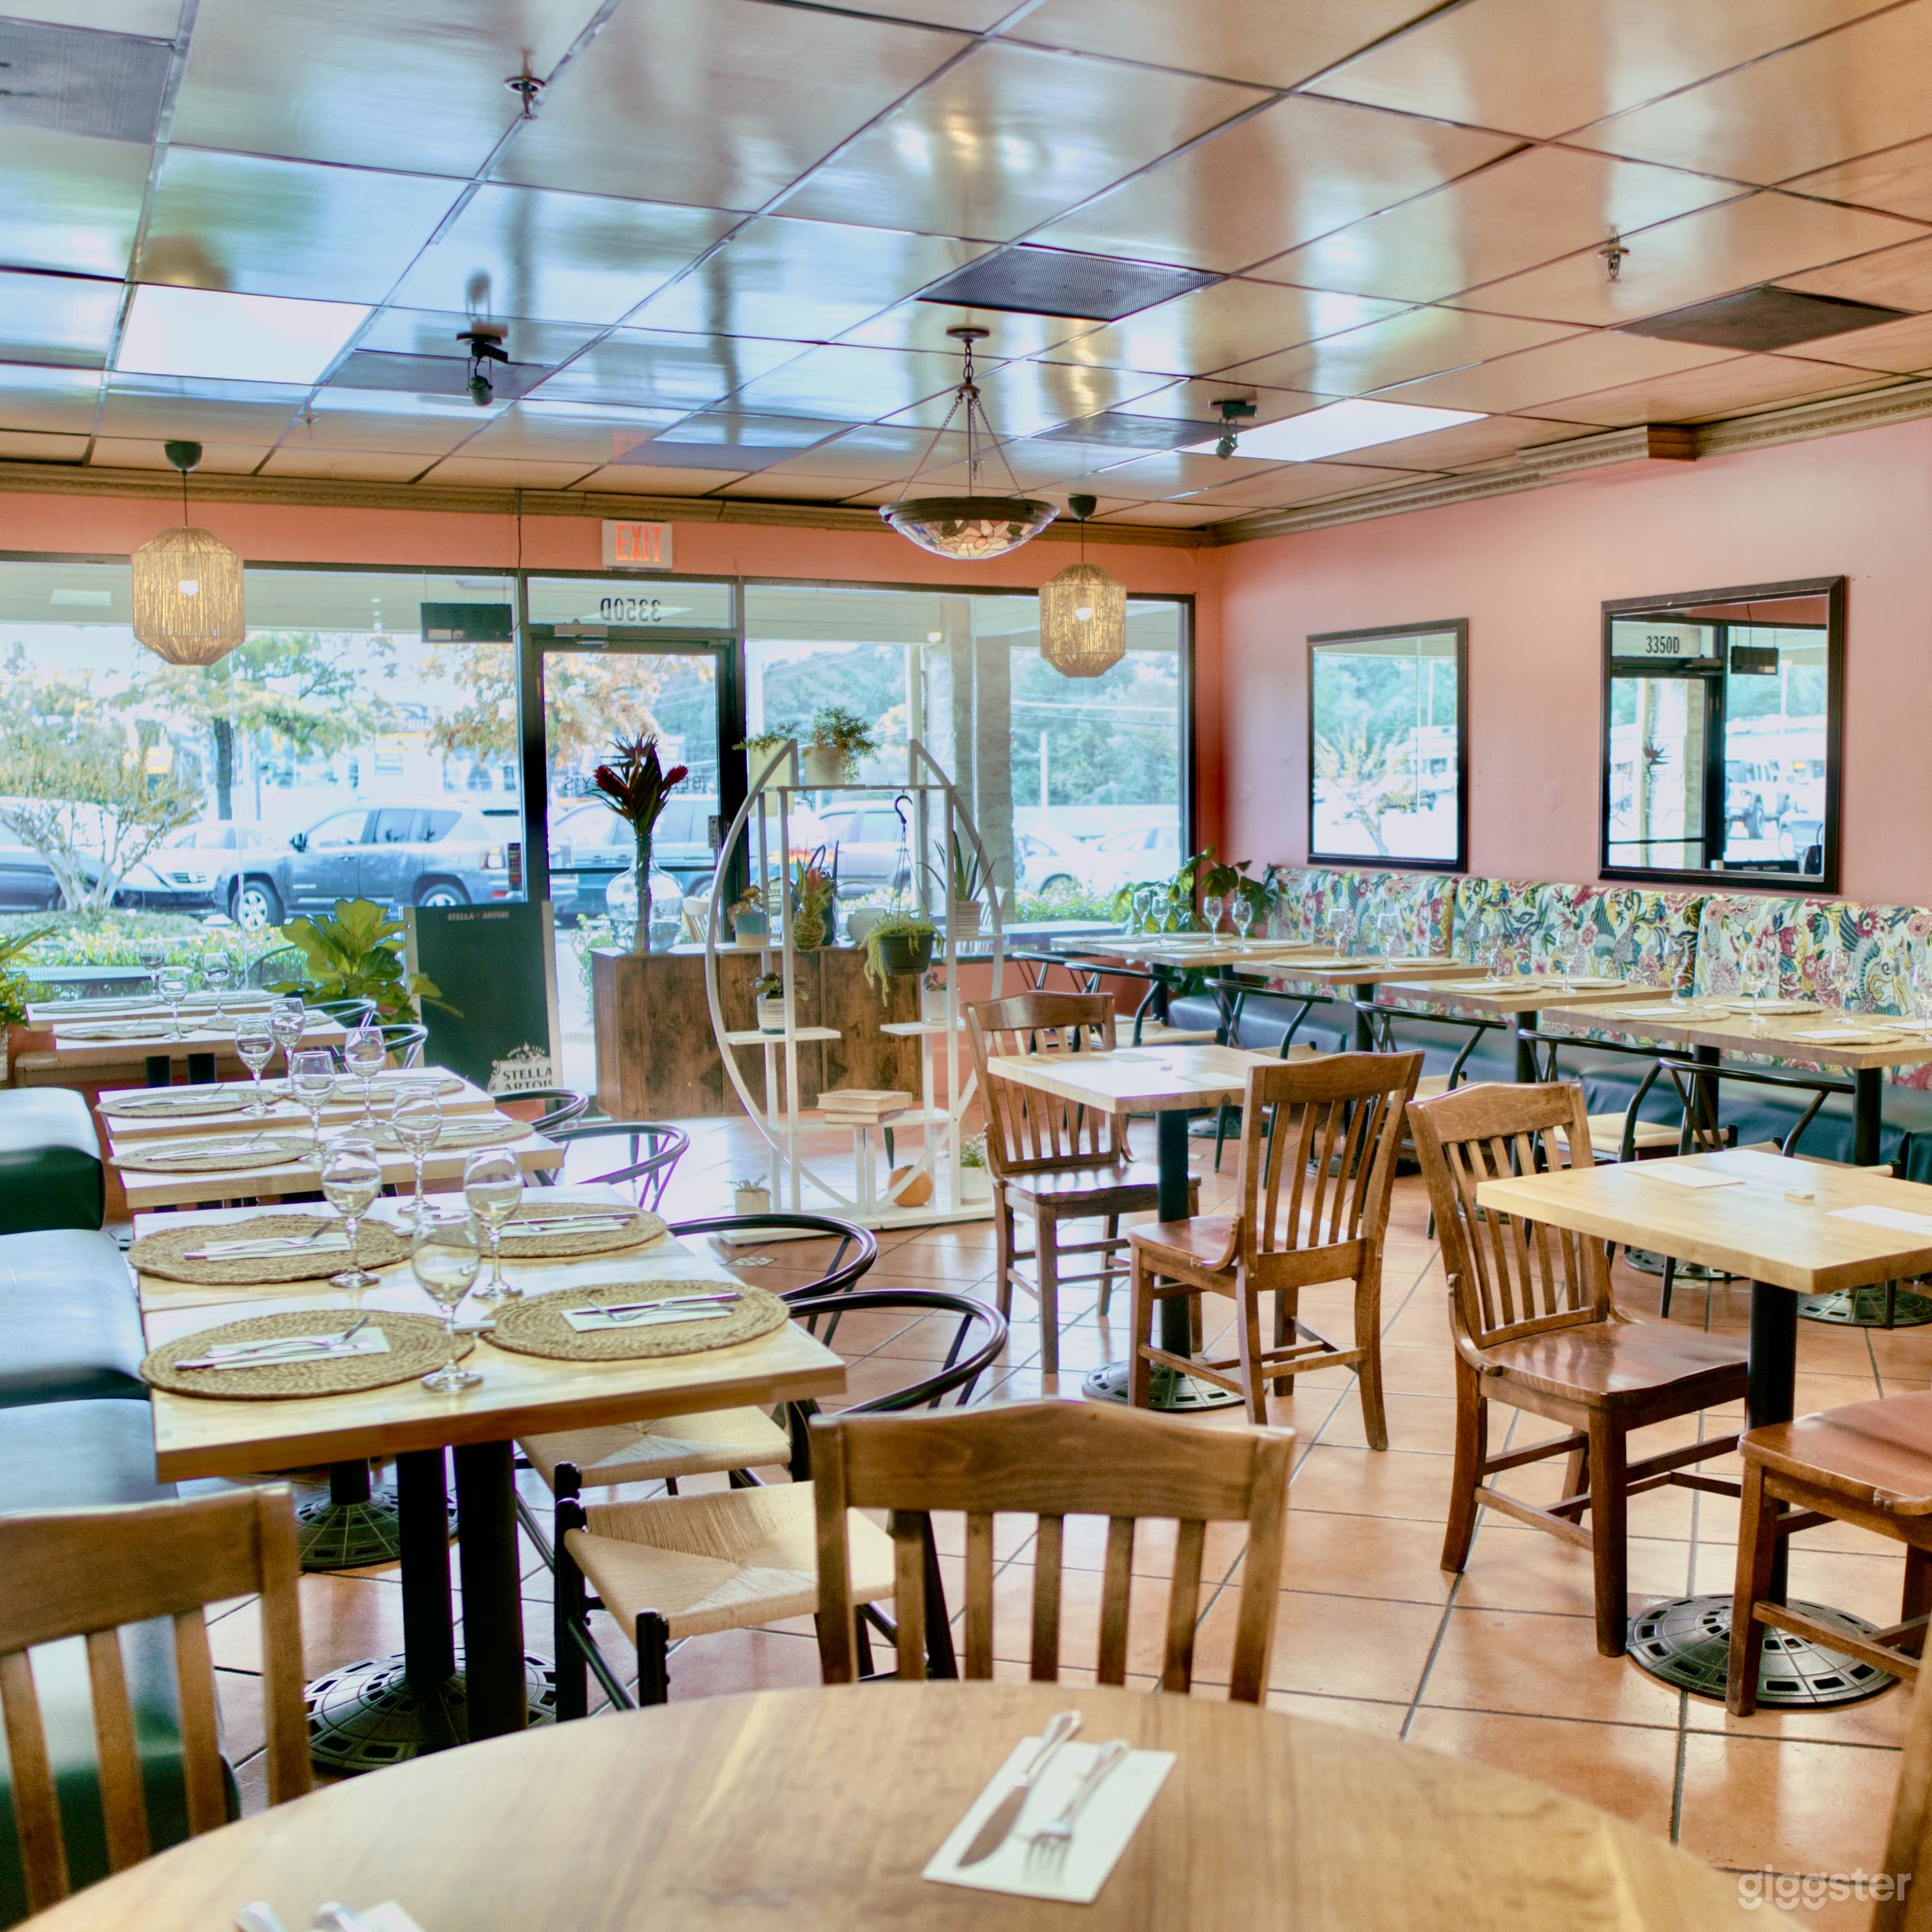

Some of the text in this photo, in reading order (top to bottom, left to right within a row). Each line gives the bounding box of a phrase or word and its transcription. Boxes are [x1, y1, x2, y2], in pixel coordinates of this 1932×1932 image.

[615, 524, 663, 562] EXIT
[1646, 635, 1680, 654] 3350D
[502, 1067, 552, 1081] STELLA
